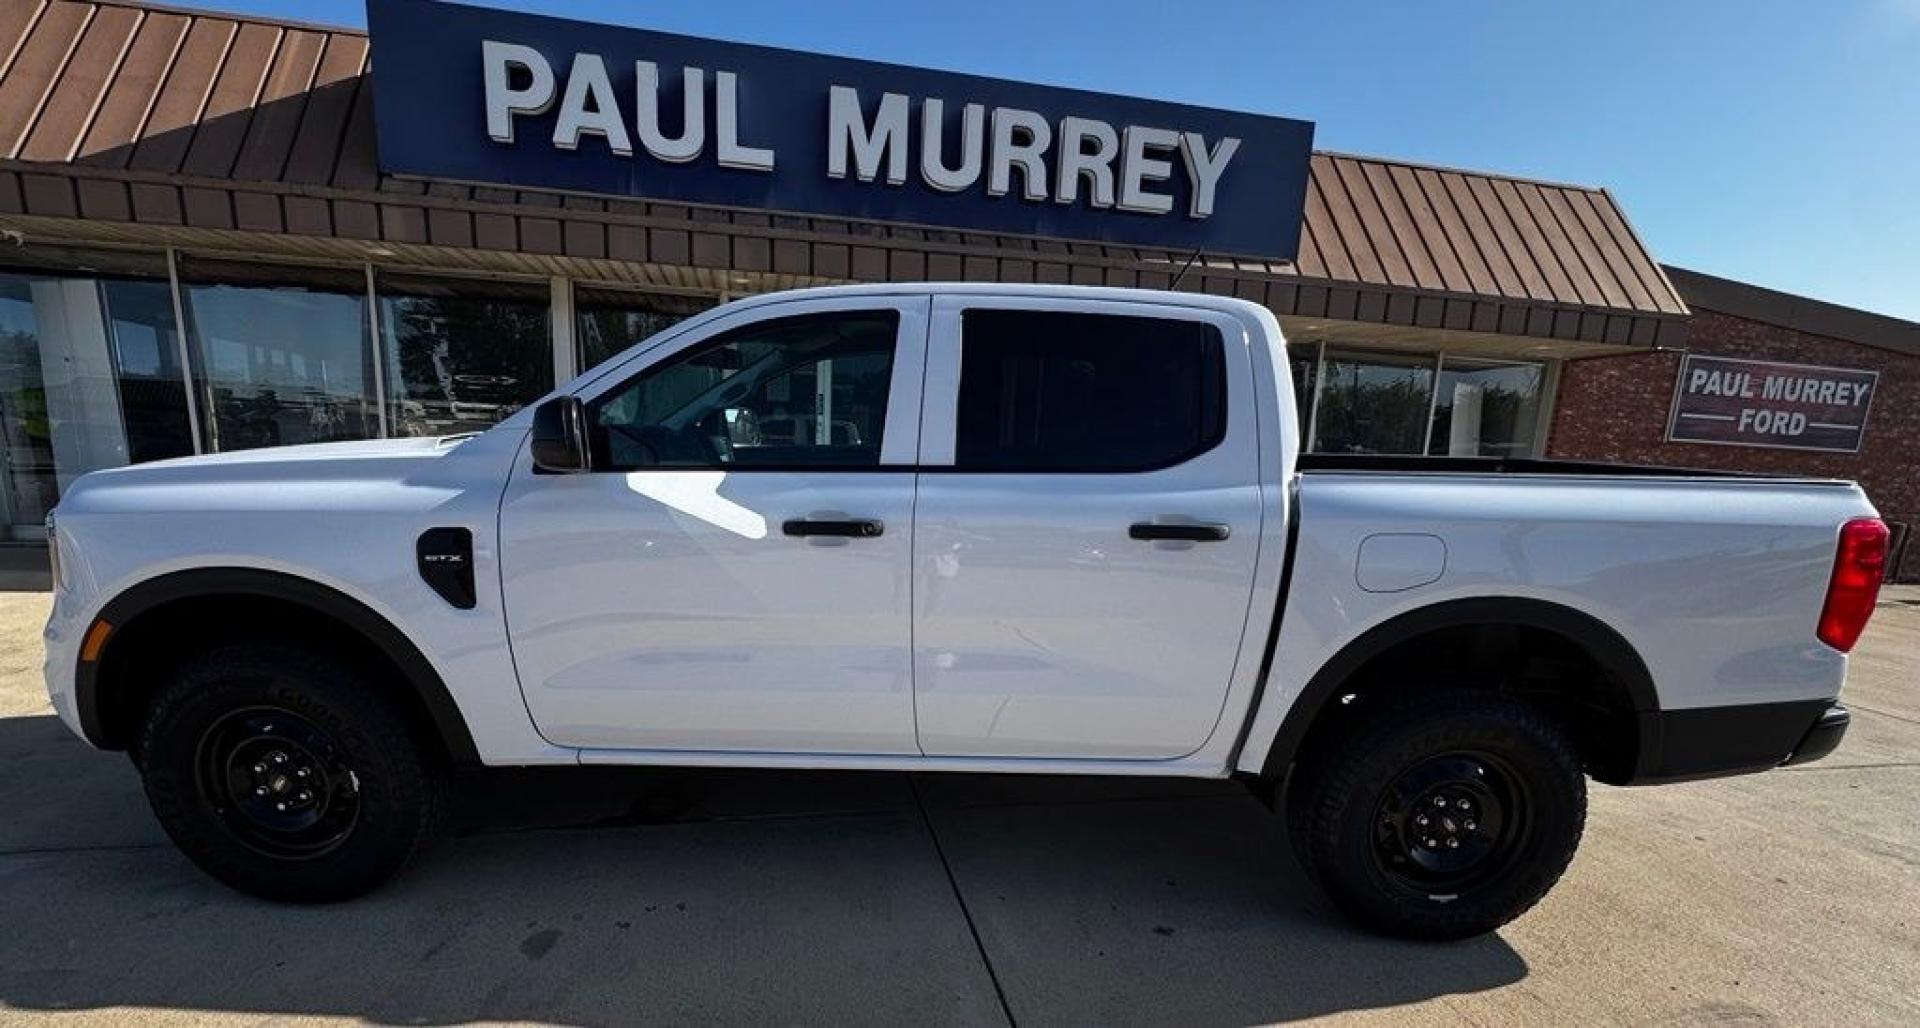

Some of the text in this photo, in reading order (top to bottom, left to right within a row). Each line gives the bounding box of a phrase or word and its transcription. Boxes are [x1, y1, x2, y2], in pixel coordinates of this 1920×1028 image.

[482, 40, 1241, 218] PAUL MURREY
[1689, 368, 1870, 406] PAUL MURREY
[1738, 408, 1806, 436] FORD
